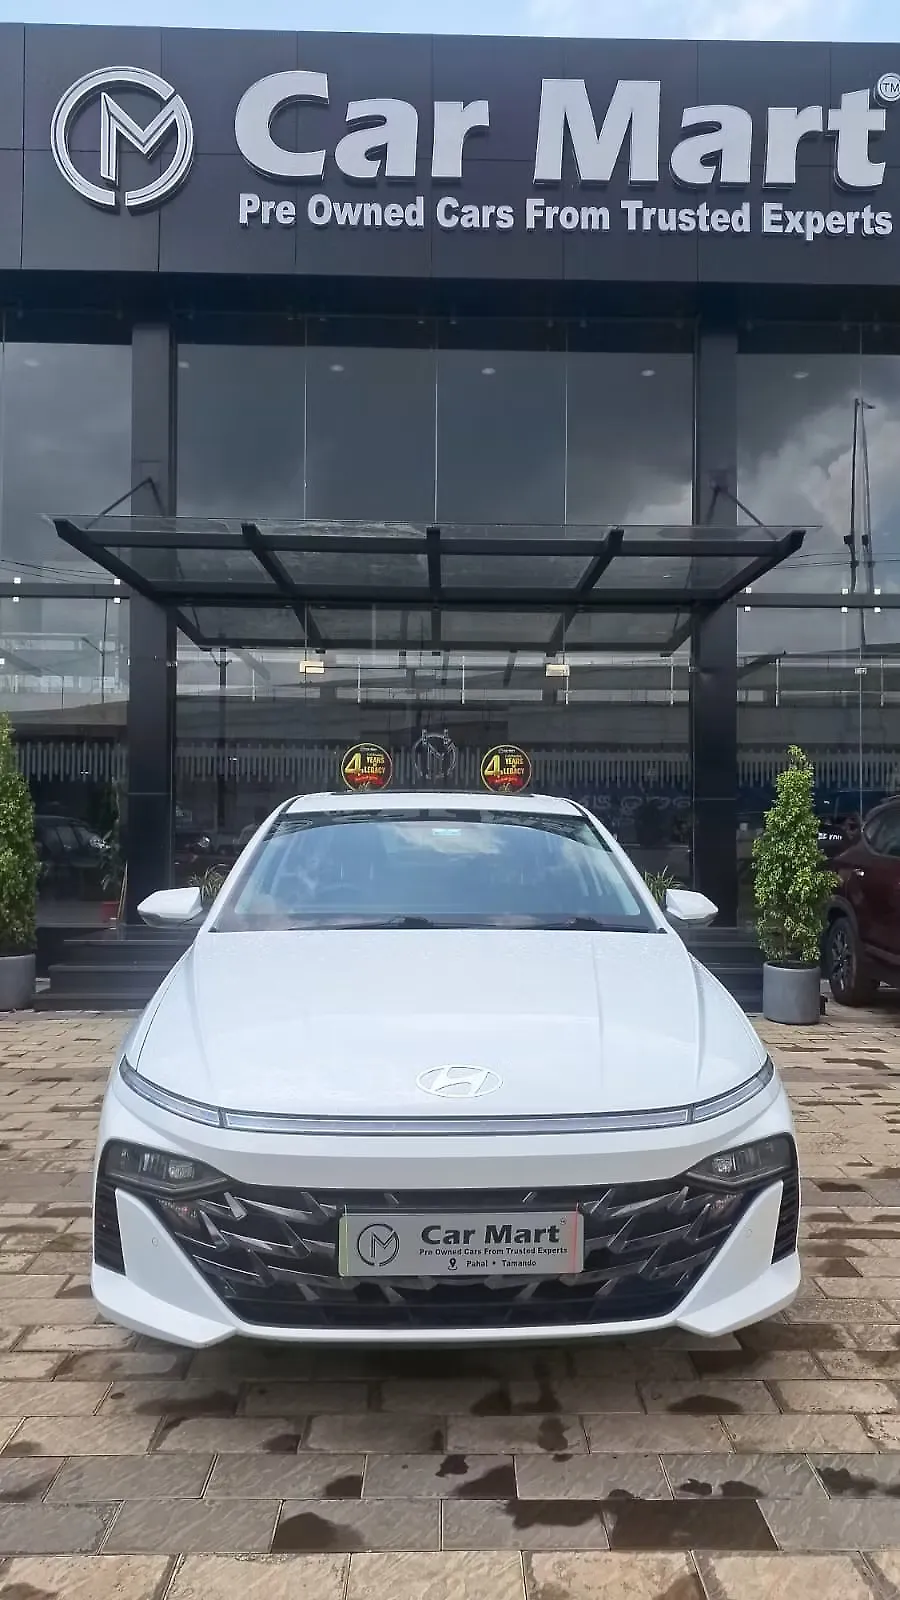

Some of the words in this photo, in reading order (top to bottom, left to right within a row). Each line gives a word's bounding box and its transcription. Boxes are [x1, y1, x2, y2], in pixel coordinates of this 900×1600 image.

[234, 70, 490, 181] Car
[533, 78, 887, 189] Mart
[238, 193, 297, 227] Pre
[307, 193, 425, 229] Owned
[436, 196, 515, 230] Cars
[525, 198, 611, 232] From
[620, 200, 752, 234] Trusted
[762, 202, 893, 241] Experts
[421, 1225, 476, 1245] Car
[484, 1224, 560, 1244] Mart
[419, 1248, 433, 1256] Pre
[435, 1248, 462, 1256] Owned
[464, 1248, 482, 1256] Cars
[484, 1247, 504, 1255] From
[505, 1247, 536, 1255] Trusted
[537, 1246, 568, 1256] Experts
[466, 1260, 488, 1268] Pahal
[501, 1259, 537, 1268] Tamando
